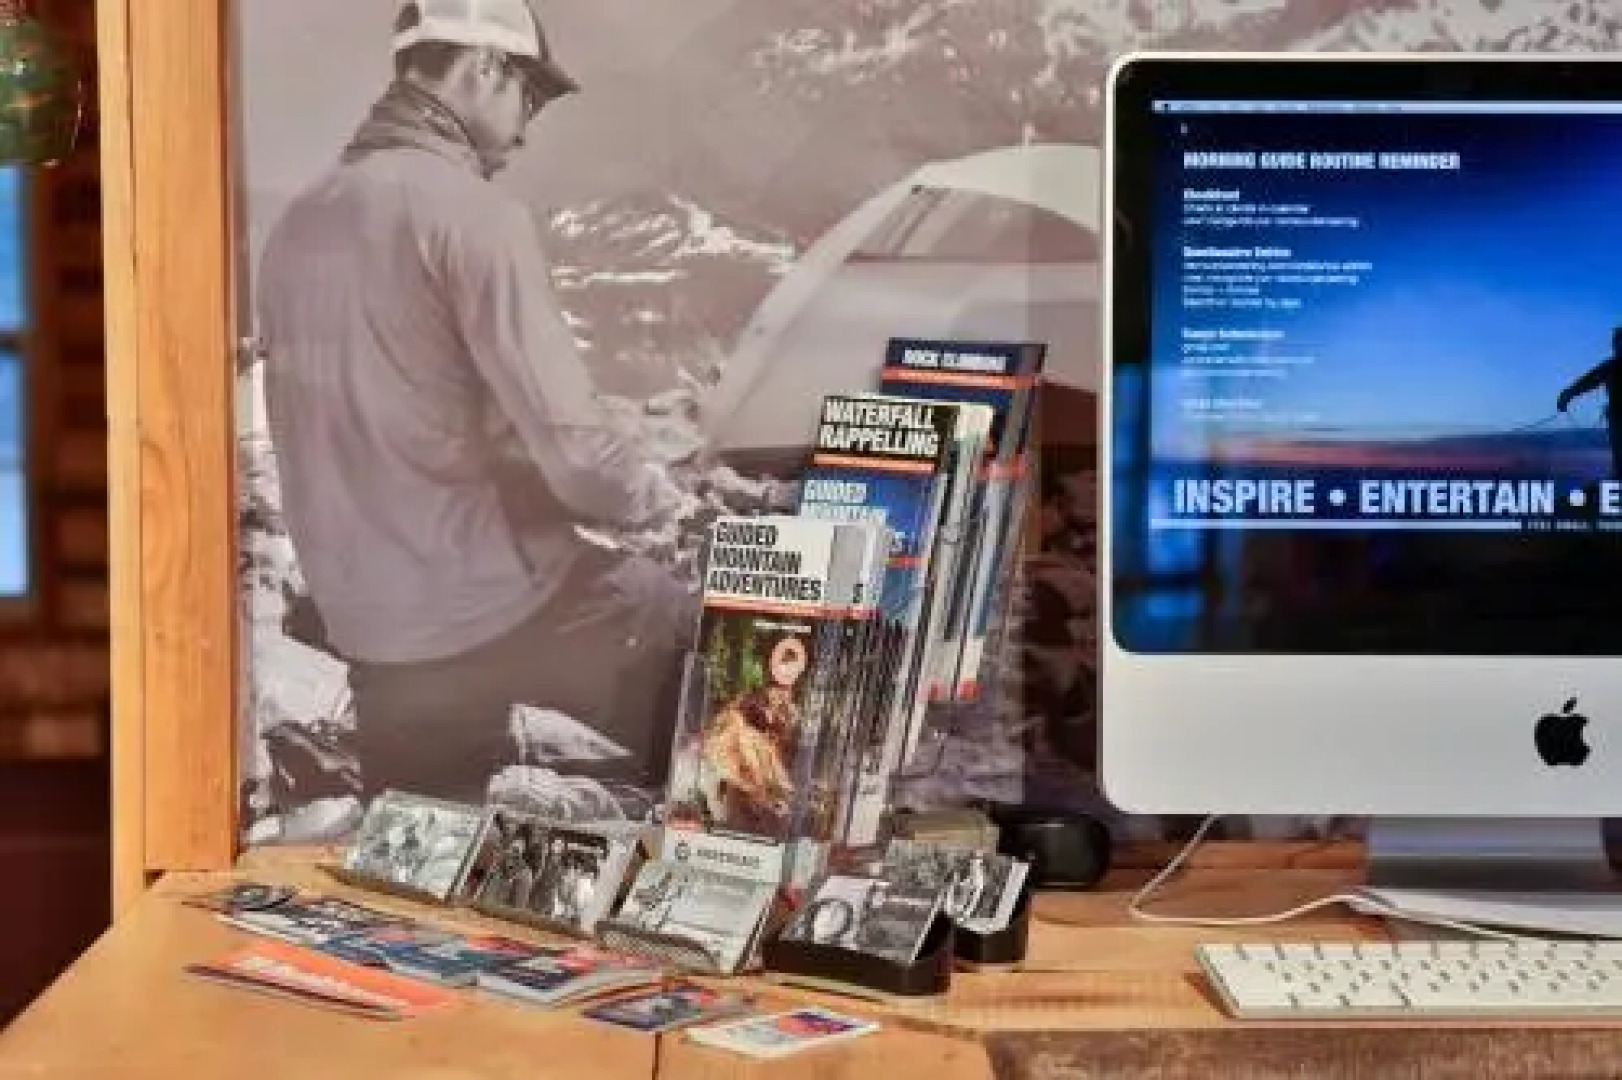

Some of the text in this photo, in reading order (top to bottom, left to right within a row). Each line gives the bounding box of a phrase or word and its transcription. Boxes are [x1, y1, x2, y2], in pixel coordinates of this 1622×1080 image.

[826, 400, 935, 428] WATERFALL
[820, 425, 939, 456] RAPPELLING
[1174, 480, 1314, 513] INSPIRE
[1360, 480, 1554, 513] ENTERTAIN
[716, 521, 779, 545] GUIDED
[712, 547, 802, 575] MOUNTAIN
[707, 570, 822, 601] ADVENTURES
